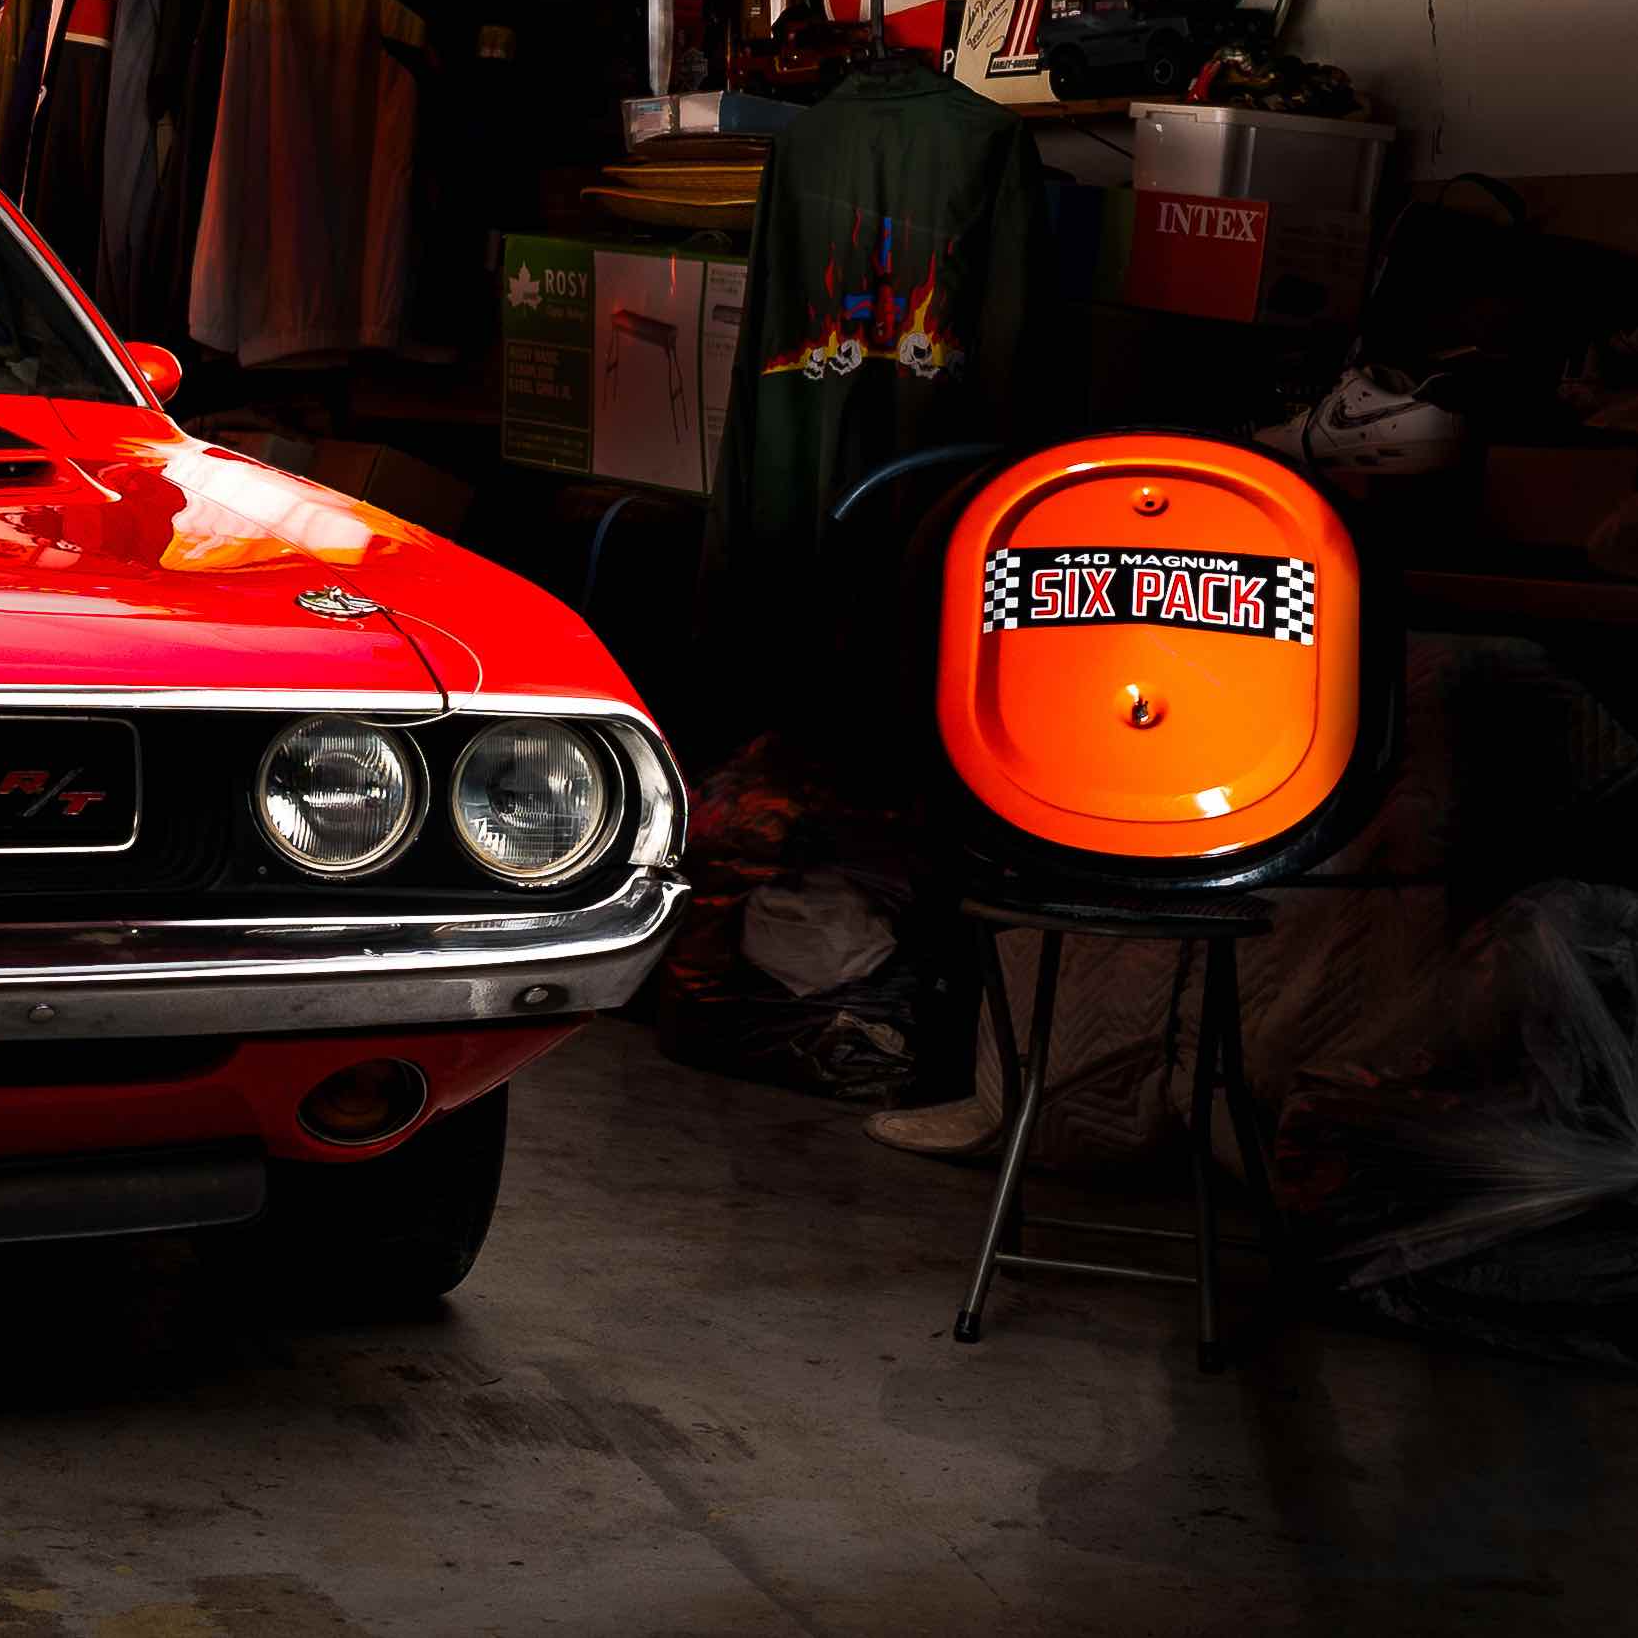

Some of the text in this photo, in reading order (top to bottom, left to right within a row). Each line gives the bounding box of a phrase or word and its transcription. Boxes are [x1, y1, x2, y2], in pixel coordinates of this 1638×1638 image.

[1155, 201, 1263, 243] INTEX
[545, 268, 589, 299] ROSY
[1054, 553, 1239, 572] 440 MAGNUM
[1030, 568, 1268, 630] SIX PACK
